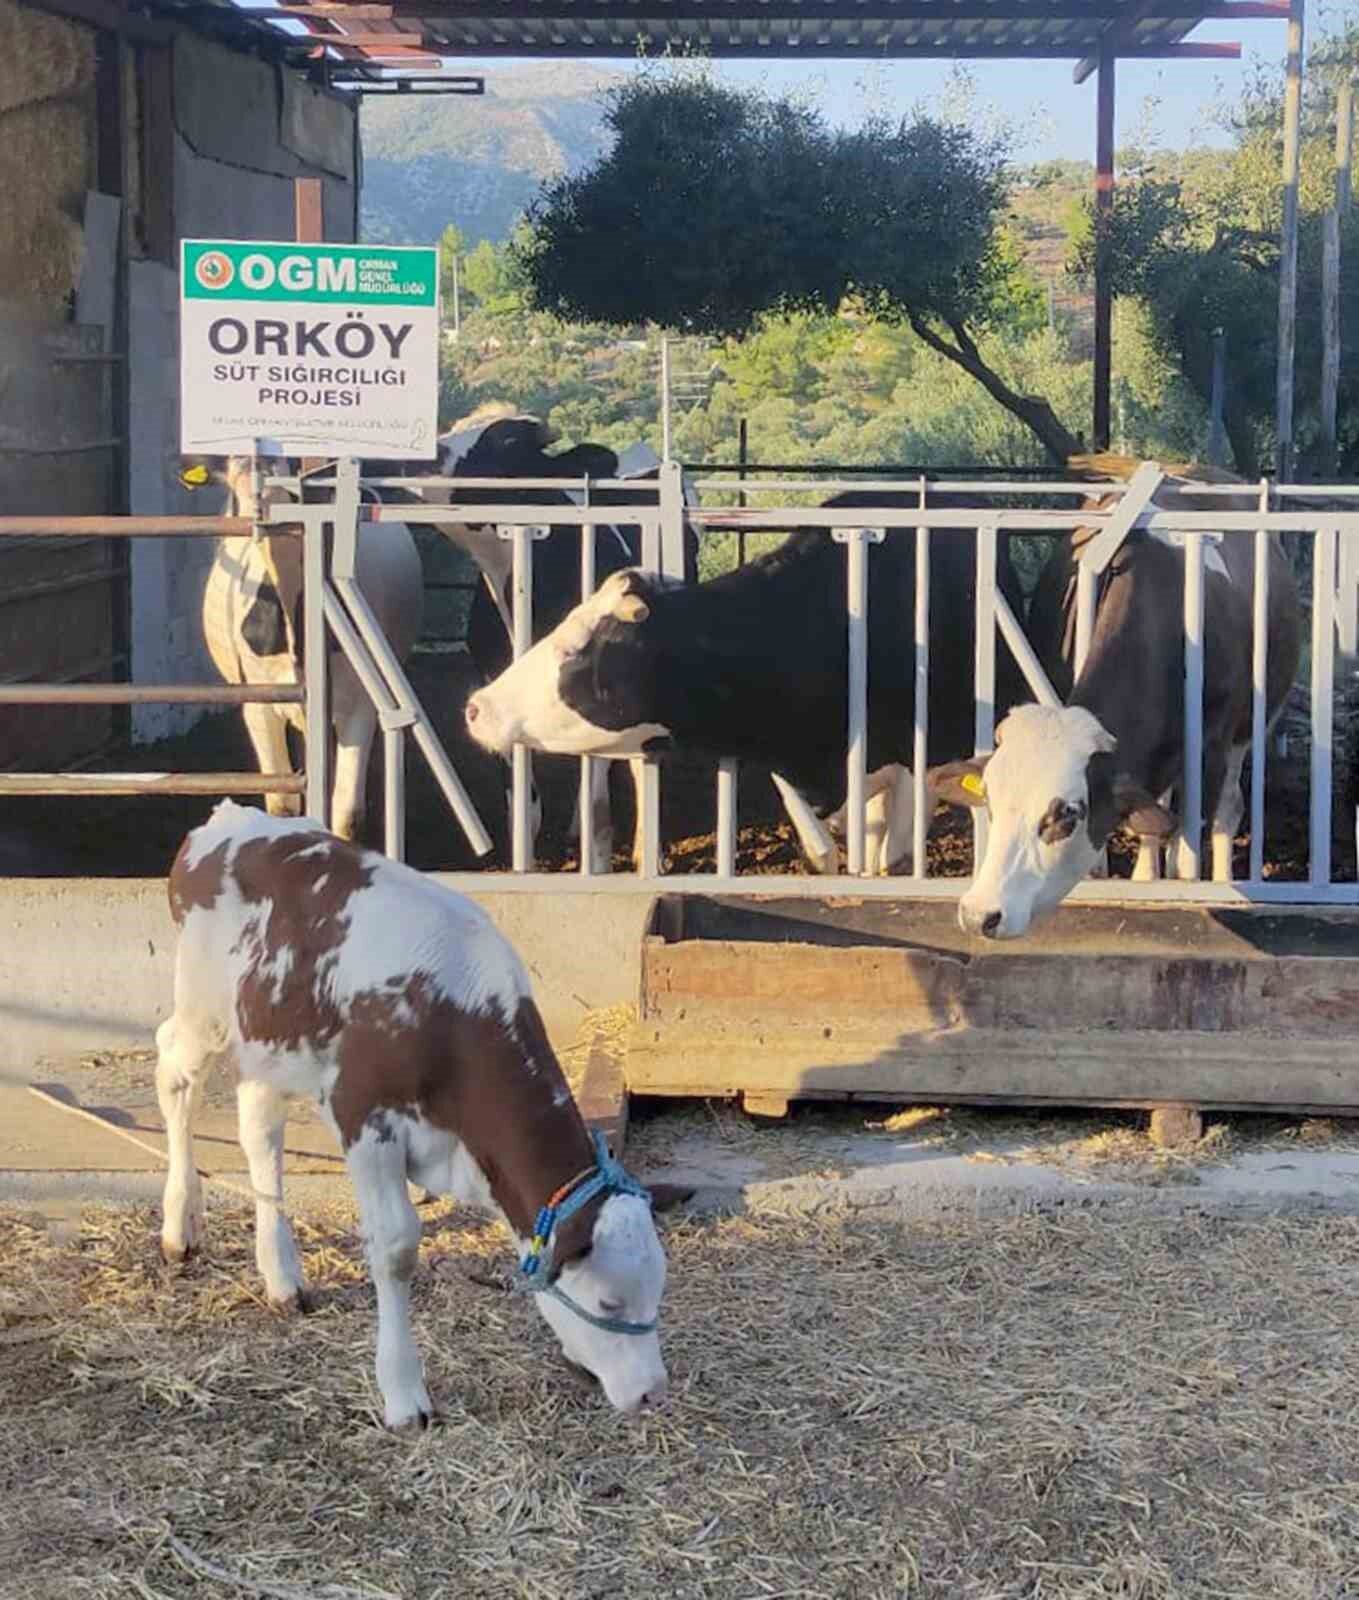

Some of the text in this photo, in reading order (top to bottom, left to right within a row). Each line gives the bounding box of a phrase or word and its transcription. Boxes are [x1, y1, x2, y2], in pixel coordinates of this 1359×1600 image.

[240, 254, 355, 292] OGM
[208, 312, 413, 359] ORKÖY
[214, 362, 259, 382] SÜT
[259, 387, 361, 406] PROJESİ
